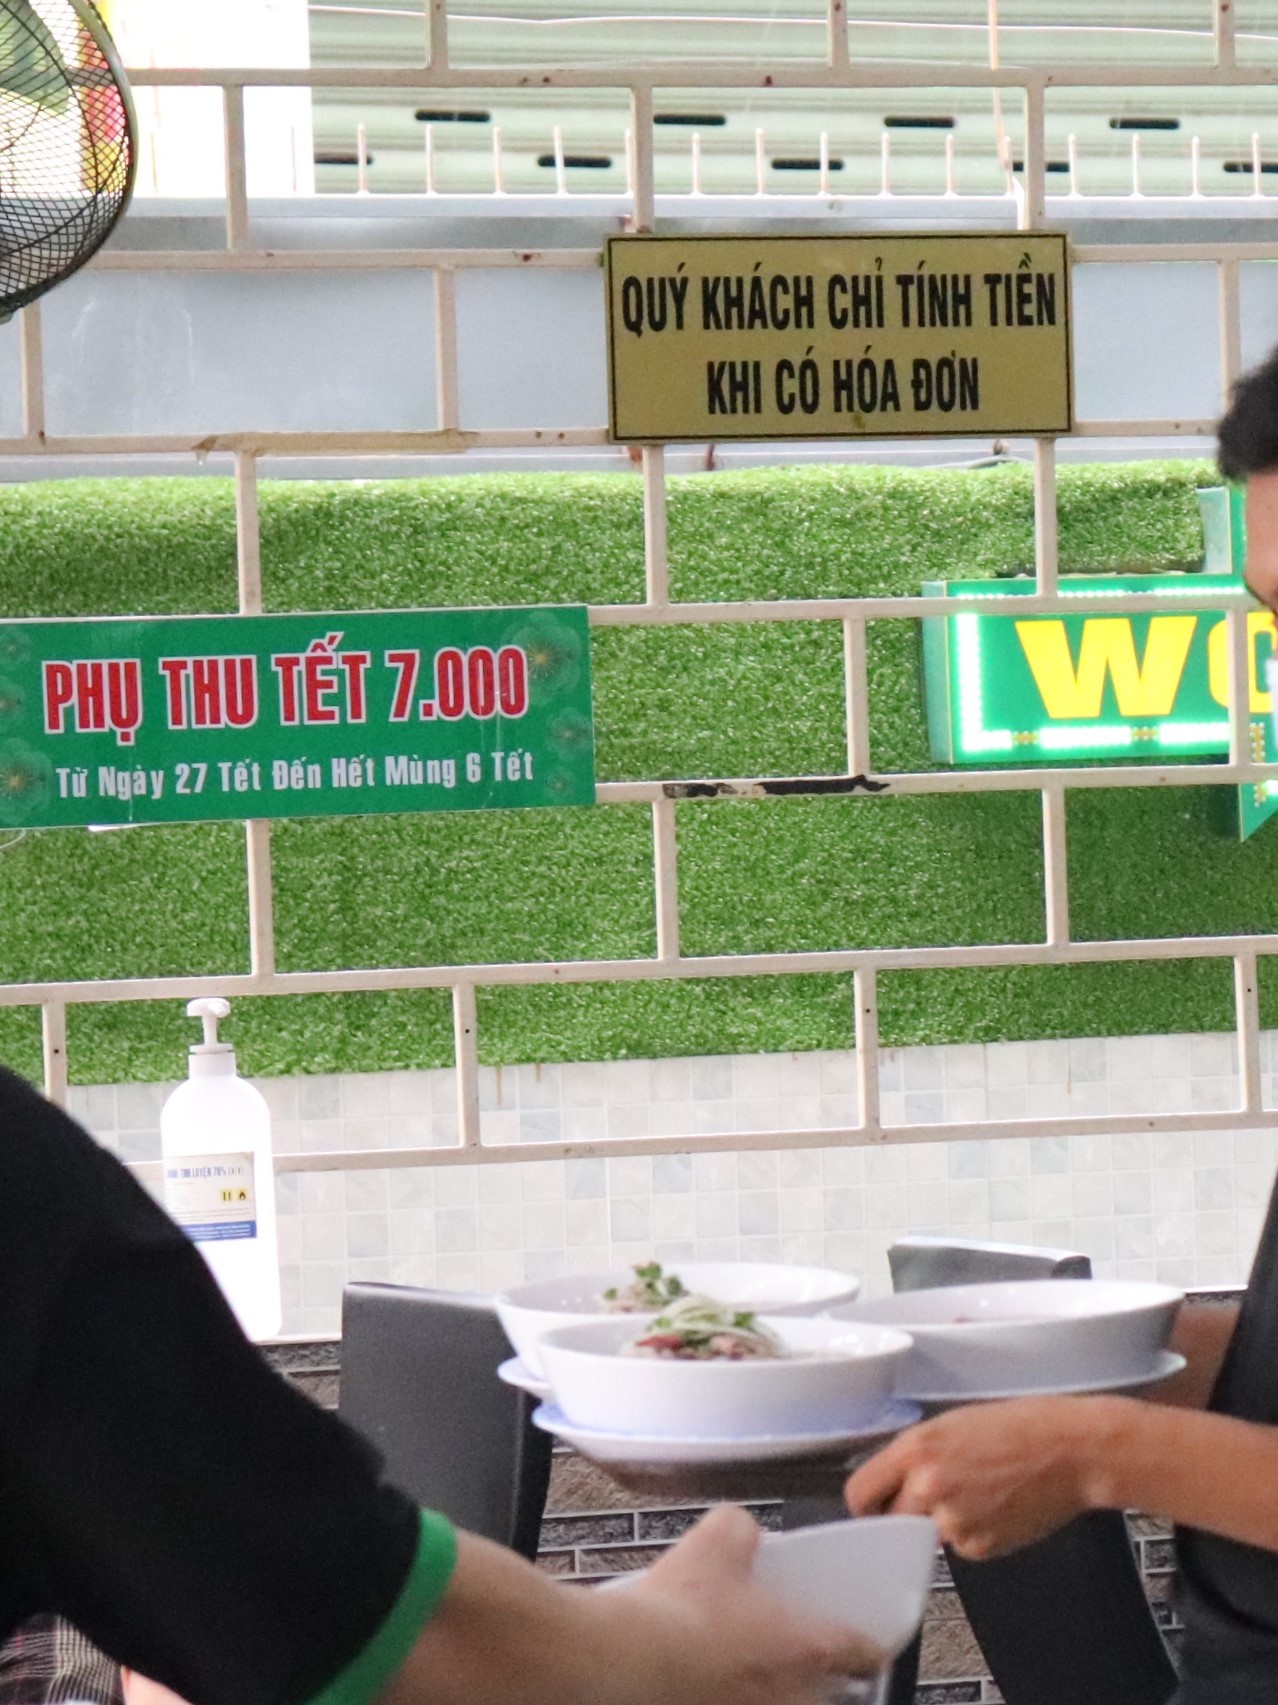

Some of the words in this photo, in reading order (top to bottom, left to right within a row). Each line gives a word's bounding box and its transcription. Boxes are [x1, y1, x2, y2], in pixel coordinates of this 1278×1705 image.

[622, 262, 690, 337] QUÝ
[701, 262, 815, 330] KHÁCH
[828, 257, 885, 328] CHỈ
[896, 261, 973, 327] TÍNH
[984, 253, 1057, 327] TIỀN
[707, 361, 762, 415] KHI
[775, 346, 819, 414] CÓ
[833, 346, 901, 413] HÓA
[911, 351, 980, 412] ĐƠN
[42, 659, 141, 747] PHỤ
[159, 653, 257, 728] THU
[271, 631, 372, 726] TẾT
[385, 645, 529, 723] 7.000
[56, 766, 88, 799] Từ
[98, 765, 164, 801] Ngày
[175, 762, 208, 794] 27
[218, 758, 261, 792] Tết
[272, 756, 321, 790] Đến
[331, 754, 375, 788] Hết
[385, 754, 456, 788] Mùng
[466, 752, 482, 783] 6
[491, 748, 534, 782] Tết
